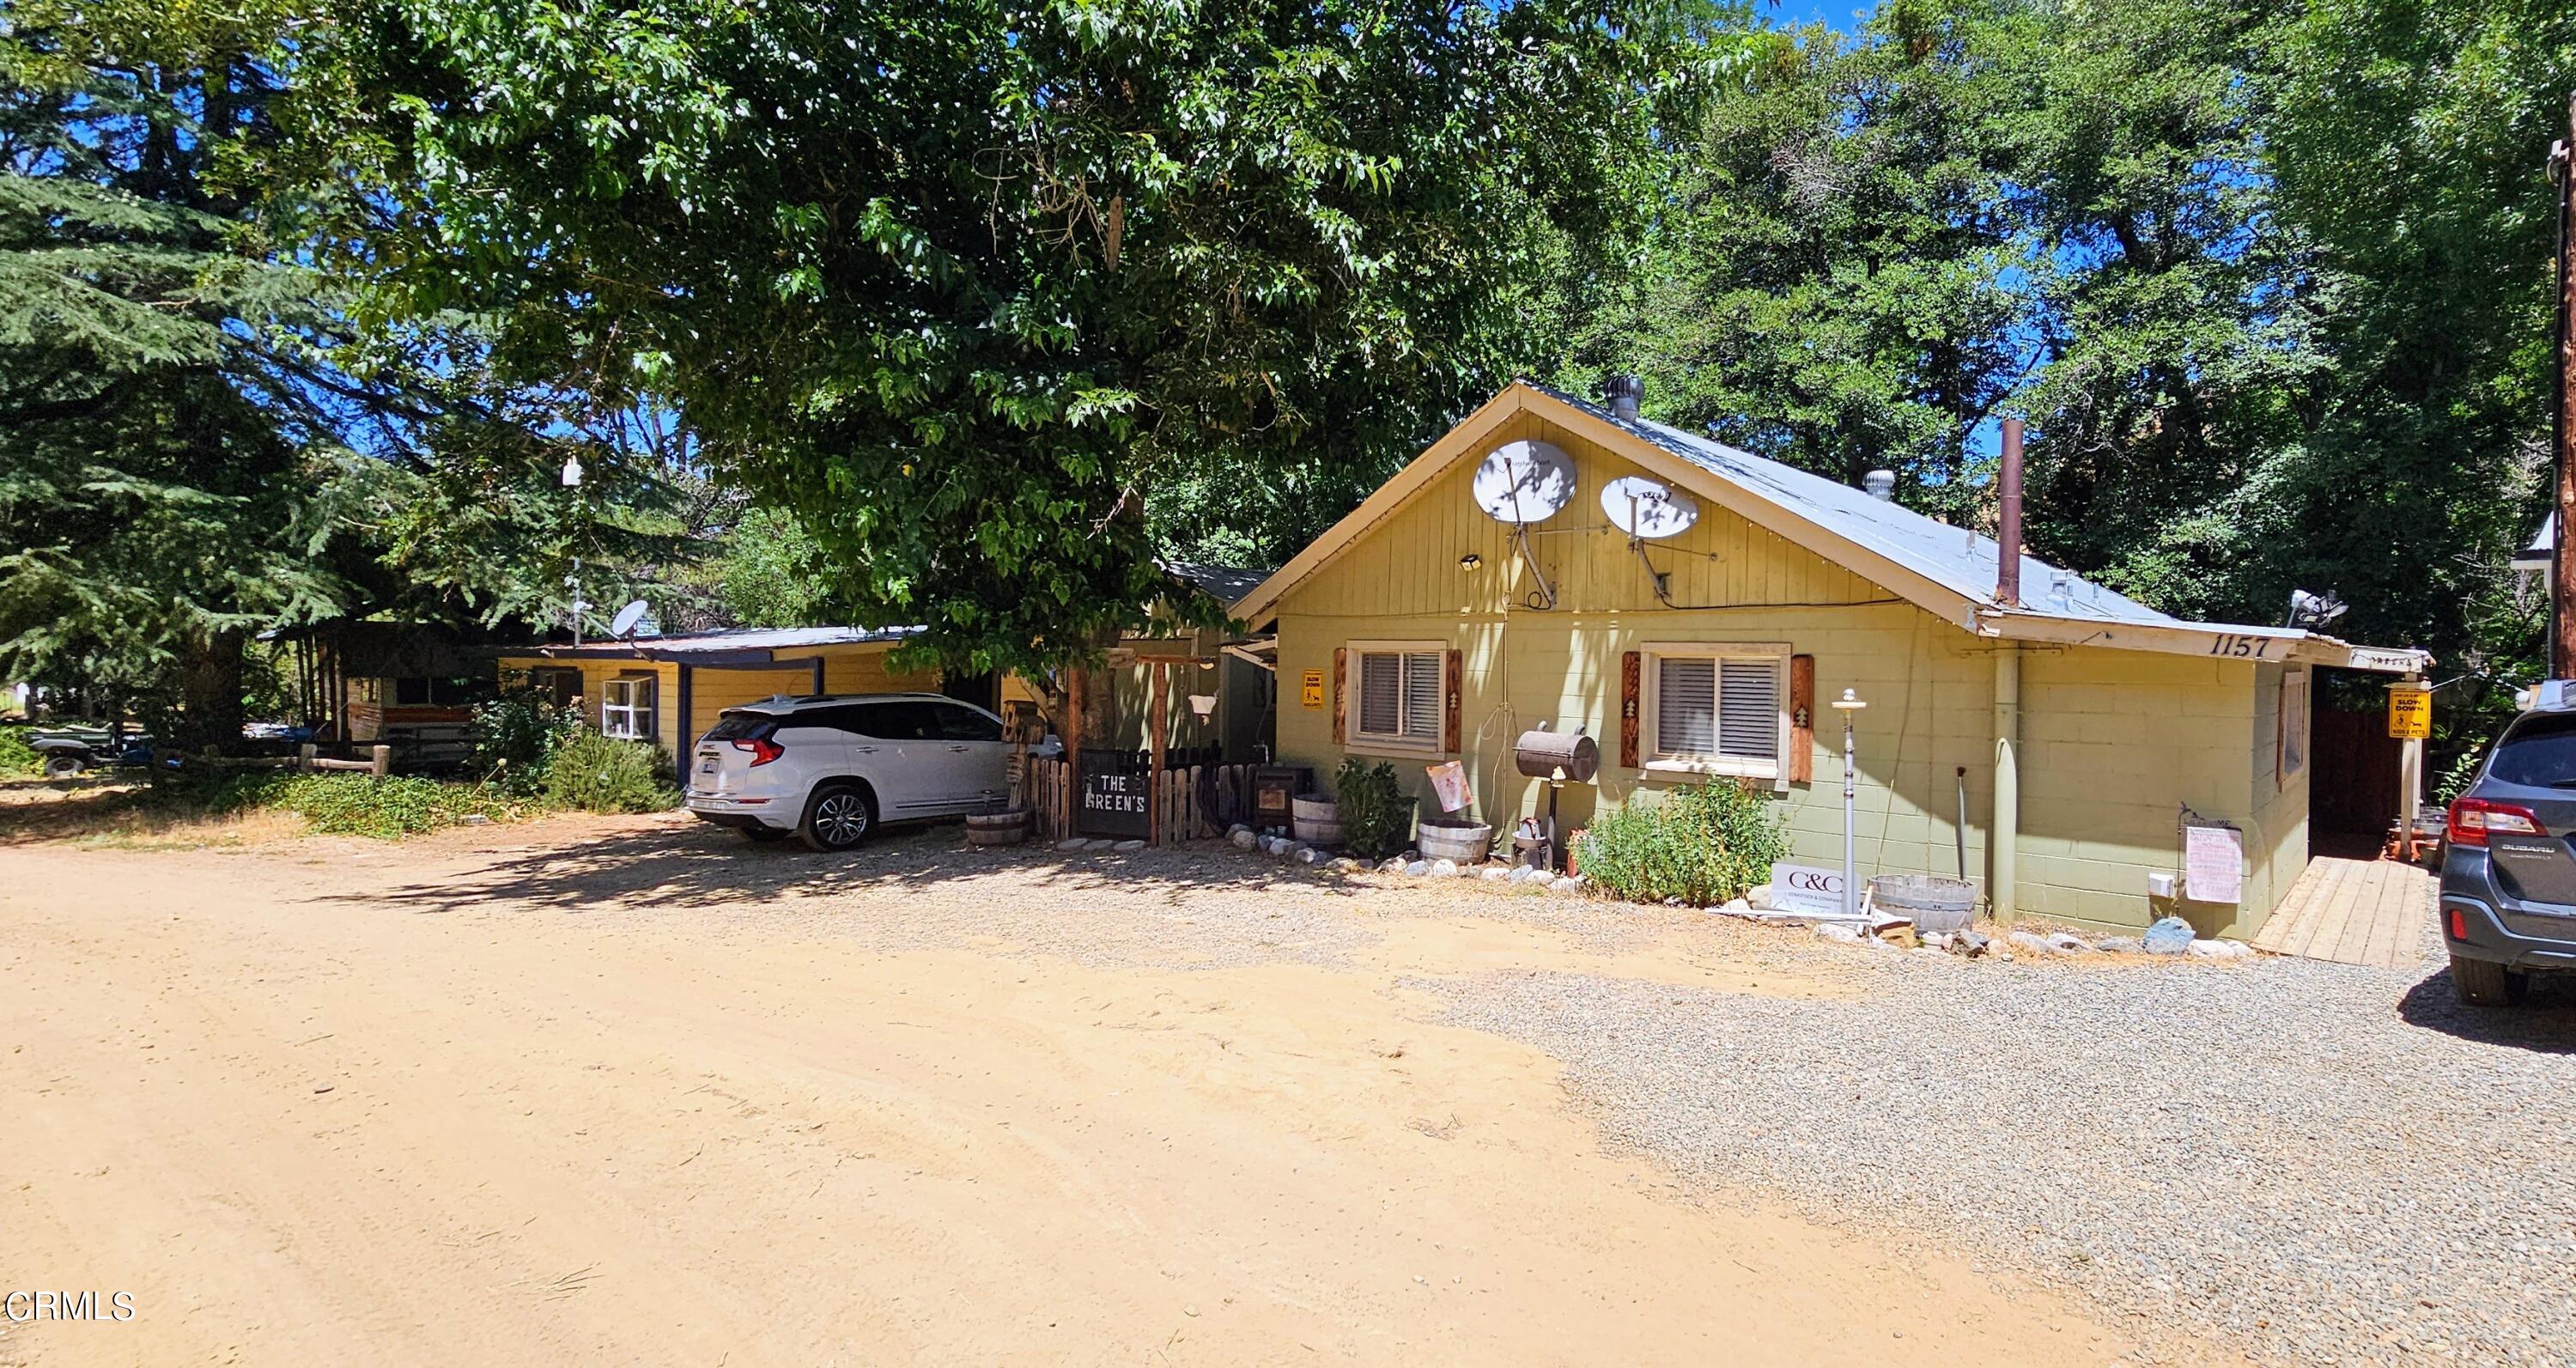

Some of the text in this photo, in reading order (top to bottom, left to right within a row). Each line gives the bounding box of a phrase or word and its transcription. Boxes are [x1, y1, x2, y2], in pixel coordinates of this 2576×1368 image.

[2210, 633, 2270, 658] 1157
[1101, 775, 1126, 792] THE
[1085, 792, 1145, 812] GREEN'S
[2501, 844, 2555, 853] SUBARU
[1789, 871, 1843, 893] C&C
[1788, 891, 1814, 900] COMSTOCK
